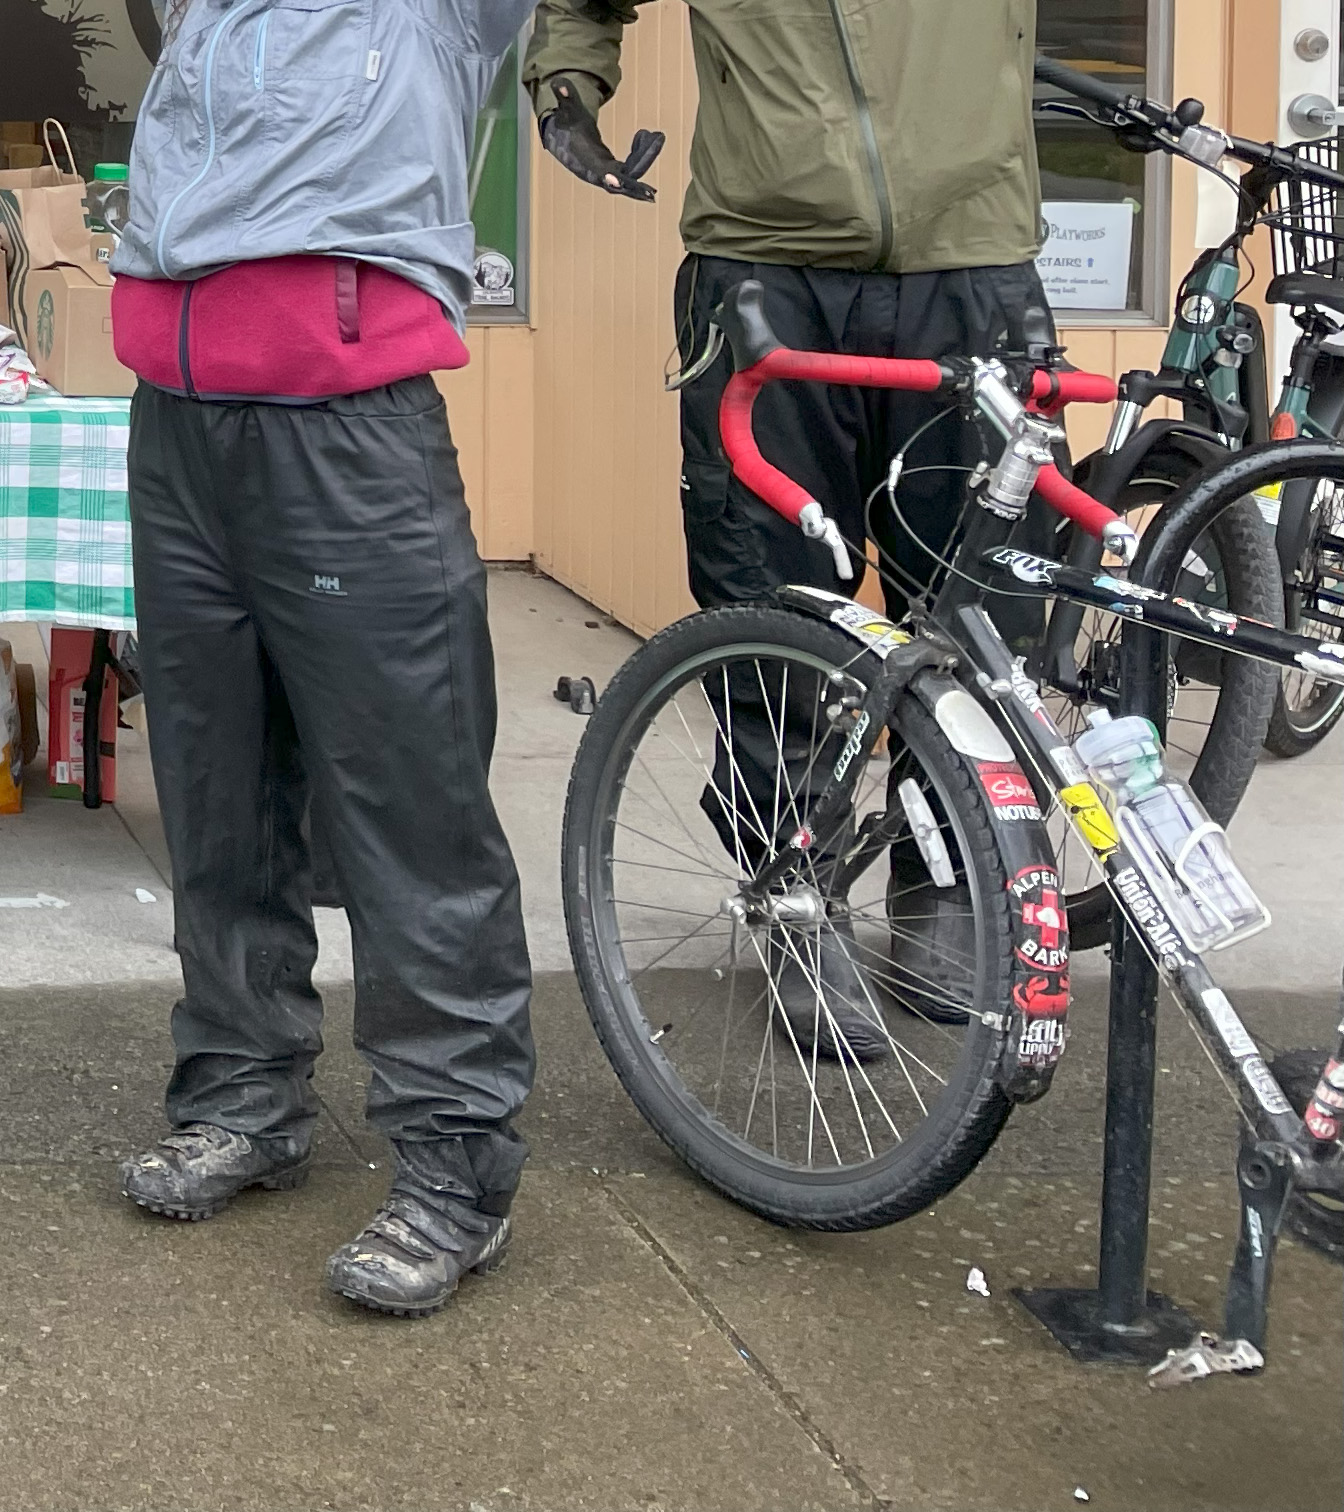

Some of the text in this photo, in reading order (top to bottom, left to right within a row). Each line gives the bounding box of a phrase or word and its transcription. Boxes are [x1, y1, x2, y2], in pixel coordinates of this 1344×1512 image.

[1036, 257, 1083, 268] STAIRS
[992, 548, 1063, 586] FOX
[314, 574, 340, 591] HH
